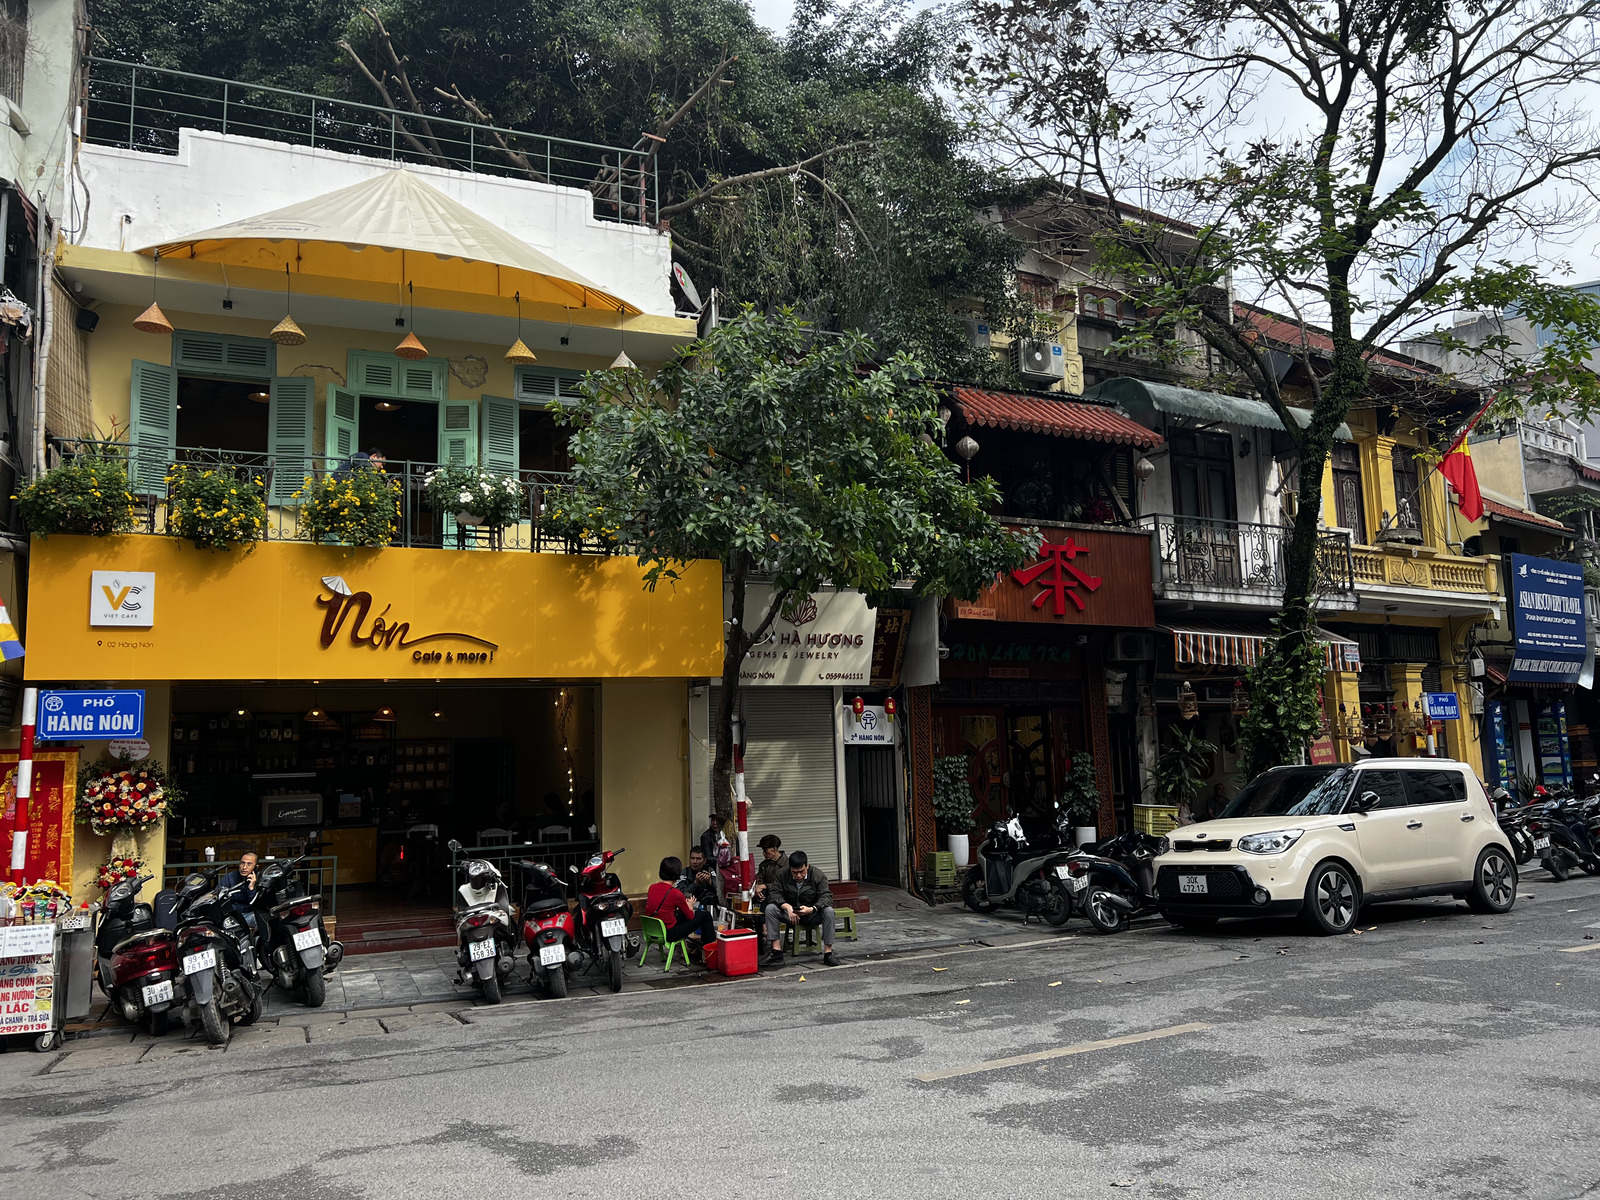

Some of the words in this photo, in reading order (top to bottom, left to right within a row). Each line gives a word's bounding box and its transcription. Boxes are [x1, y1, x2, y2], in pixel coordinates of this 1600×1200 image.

[780, 630, 802, 645] HÀ
[807, 632, 864, 646] HƯƠNG
[118, 641, 138, 649] Hàng
[412, 650, 442, 661] Cafe
[446, 651, 454, 661] &
[457, 651, 488, 662] more
[750, 651, 778, 659] GEMS
[782, 651, 789, 659] &
[794, 651, 840, 660] JEWELRY
[758, 670, 775, 680] NÓN
[83, 695, 116, 708] PHỐ
[1430, 704, 1445, 715] HÀNG
[47, 711, 94, 731] HÀNG
[98, 710, 134, 731] NÓN
[1186, 876, 1199, 884] 30K
[1182, 884, 1206, 893] 472.12
[473, 940, 491, 951] 29-E2
[543, 946, 561, 956] 29-E2
[147, 991, 169, 1005] 8191
